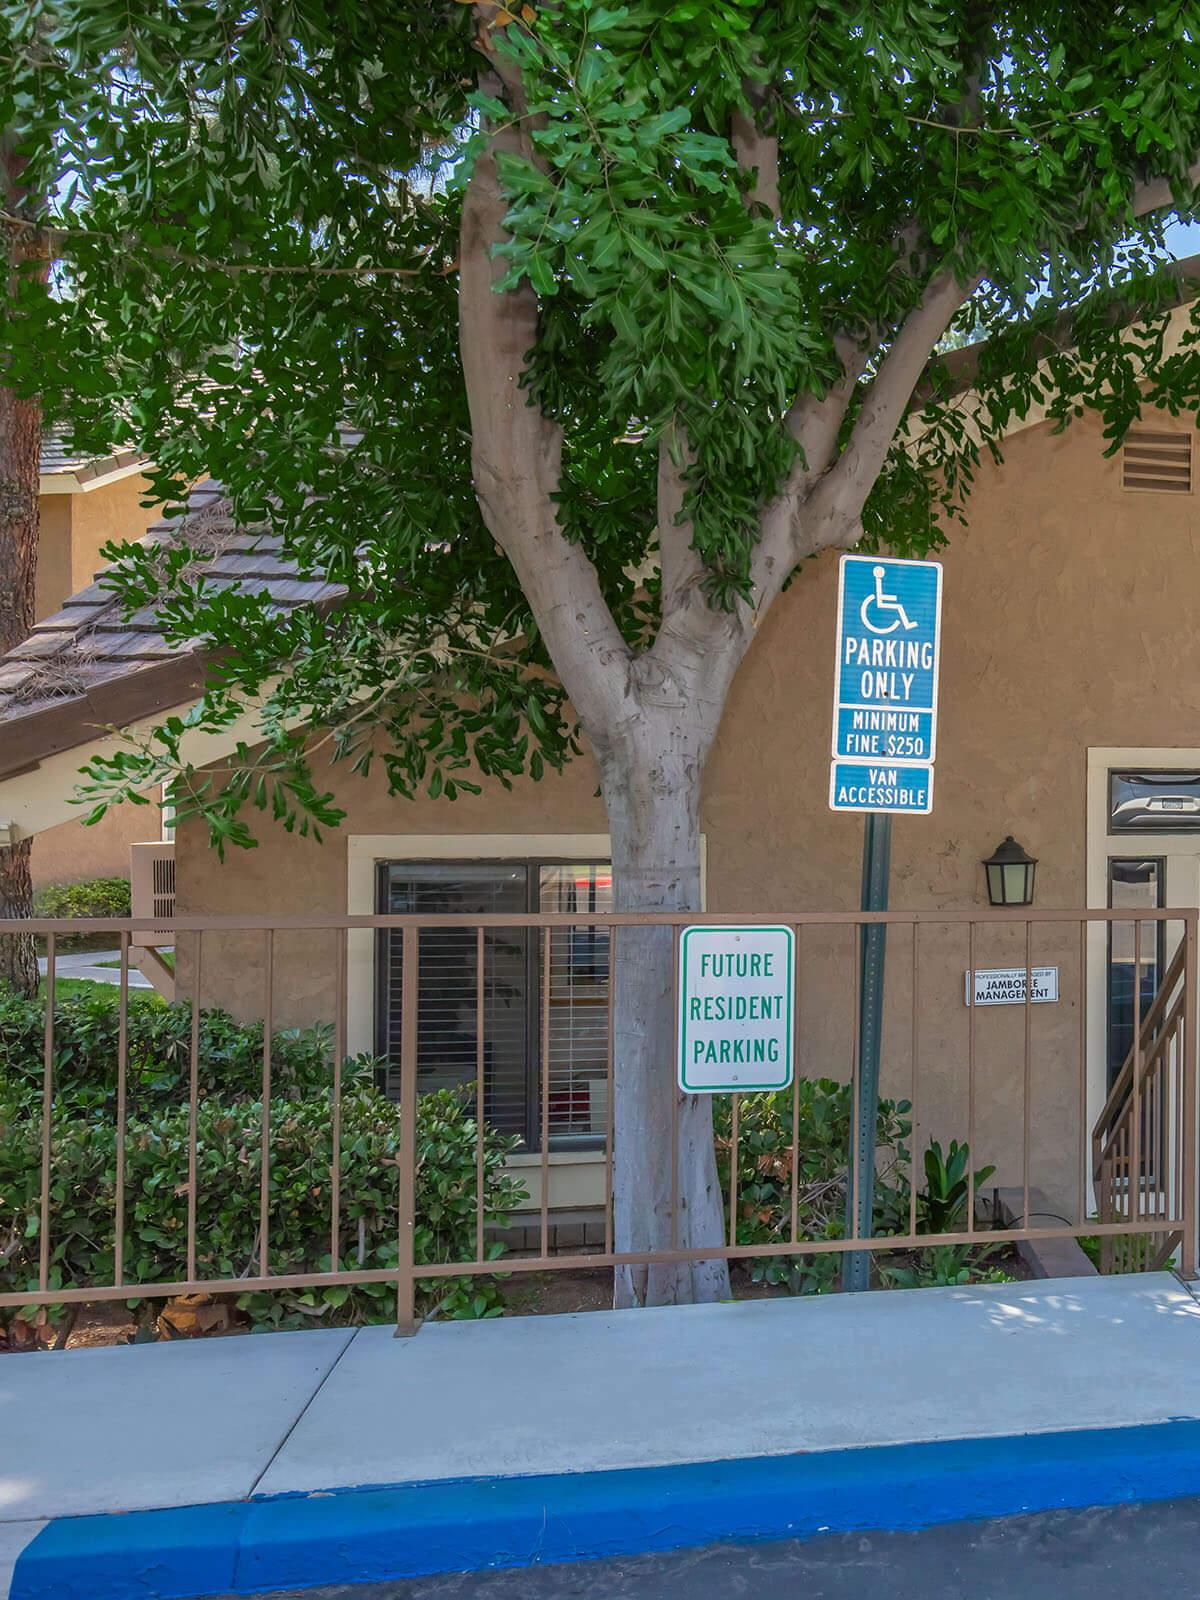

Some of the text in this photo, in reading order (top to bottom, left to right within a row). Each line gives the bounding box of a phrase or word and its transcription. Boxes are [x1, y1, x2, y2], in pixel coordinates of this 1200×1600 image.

[845, 637, 933, 670] PARKING
[860, 670, 914, 701] ONLY
[852, 711, 919, 733] MINIMUM
[845, 734, 924, 757] FINE $250
[868, 768, 897, 786] VAN
[837, 787, 926, 806] ACCESSIBLE
[701, 953, 774, 978] FUTURE
[690, 996, 784, 1021] RESIDENT
[694, 1038, 779, 1064] PARKING
